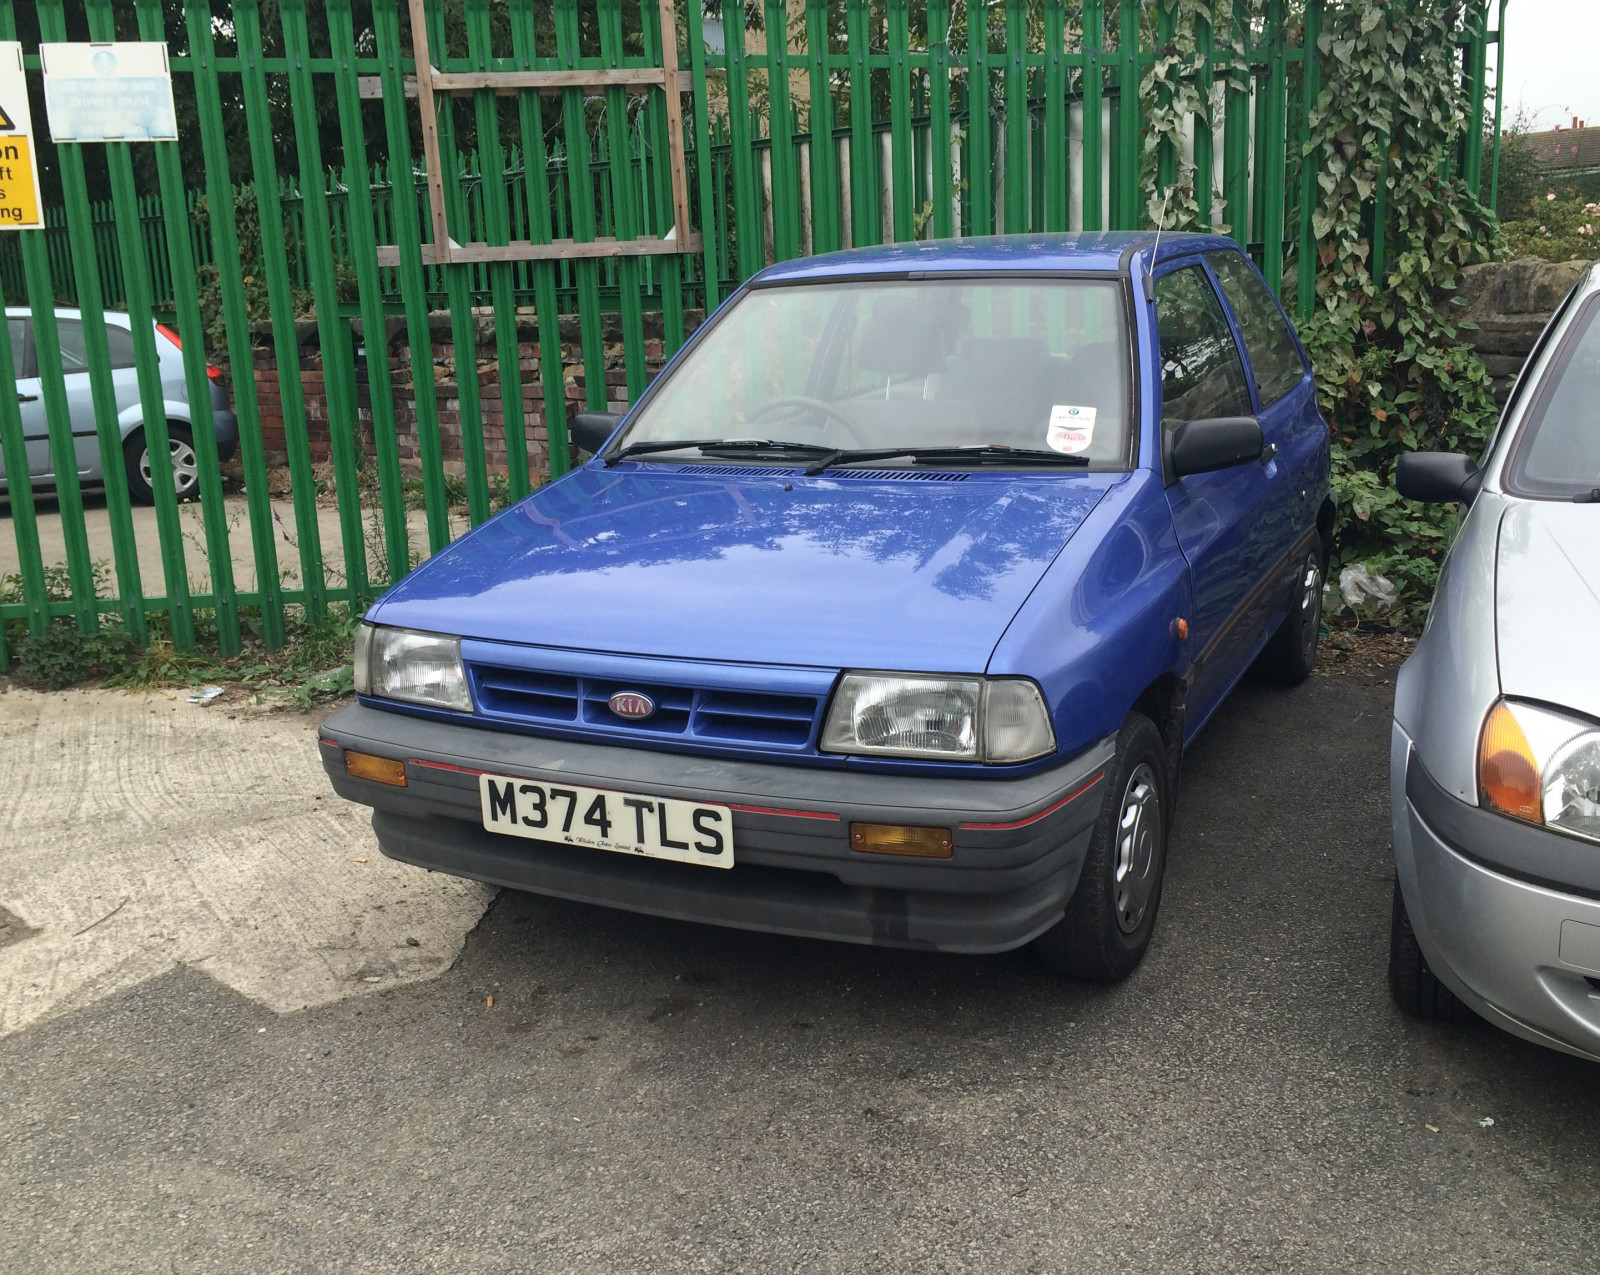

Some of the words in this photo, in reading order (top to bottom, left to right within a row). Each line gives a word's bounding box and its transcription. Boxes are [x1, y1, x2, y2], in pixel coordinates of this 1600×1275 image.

[131, 81, 155, 91] and
[71, 96, 113, 107] drivers
[118, 95, 150, 106] must
[0, 146, 18, 160] n
[616, 698, 646, 713] KIA
[488, 779, 612, 839] M374
[623, 796, 724, 856] TLS
